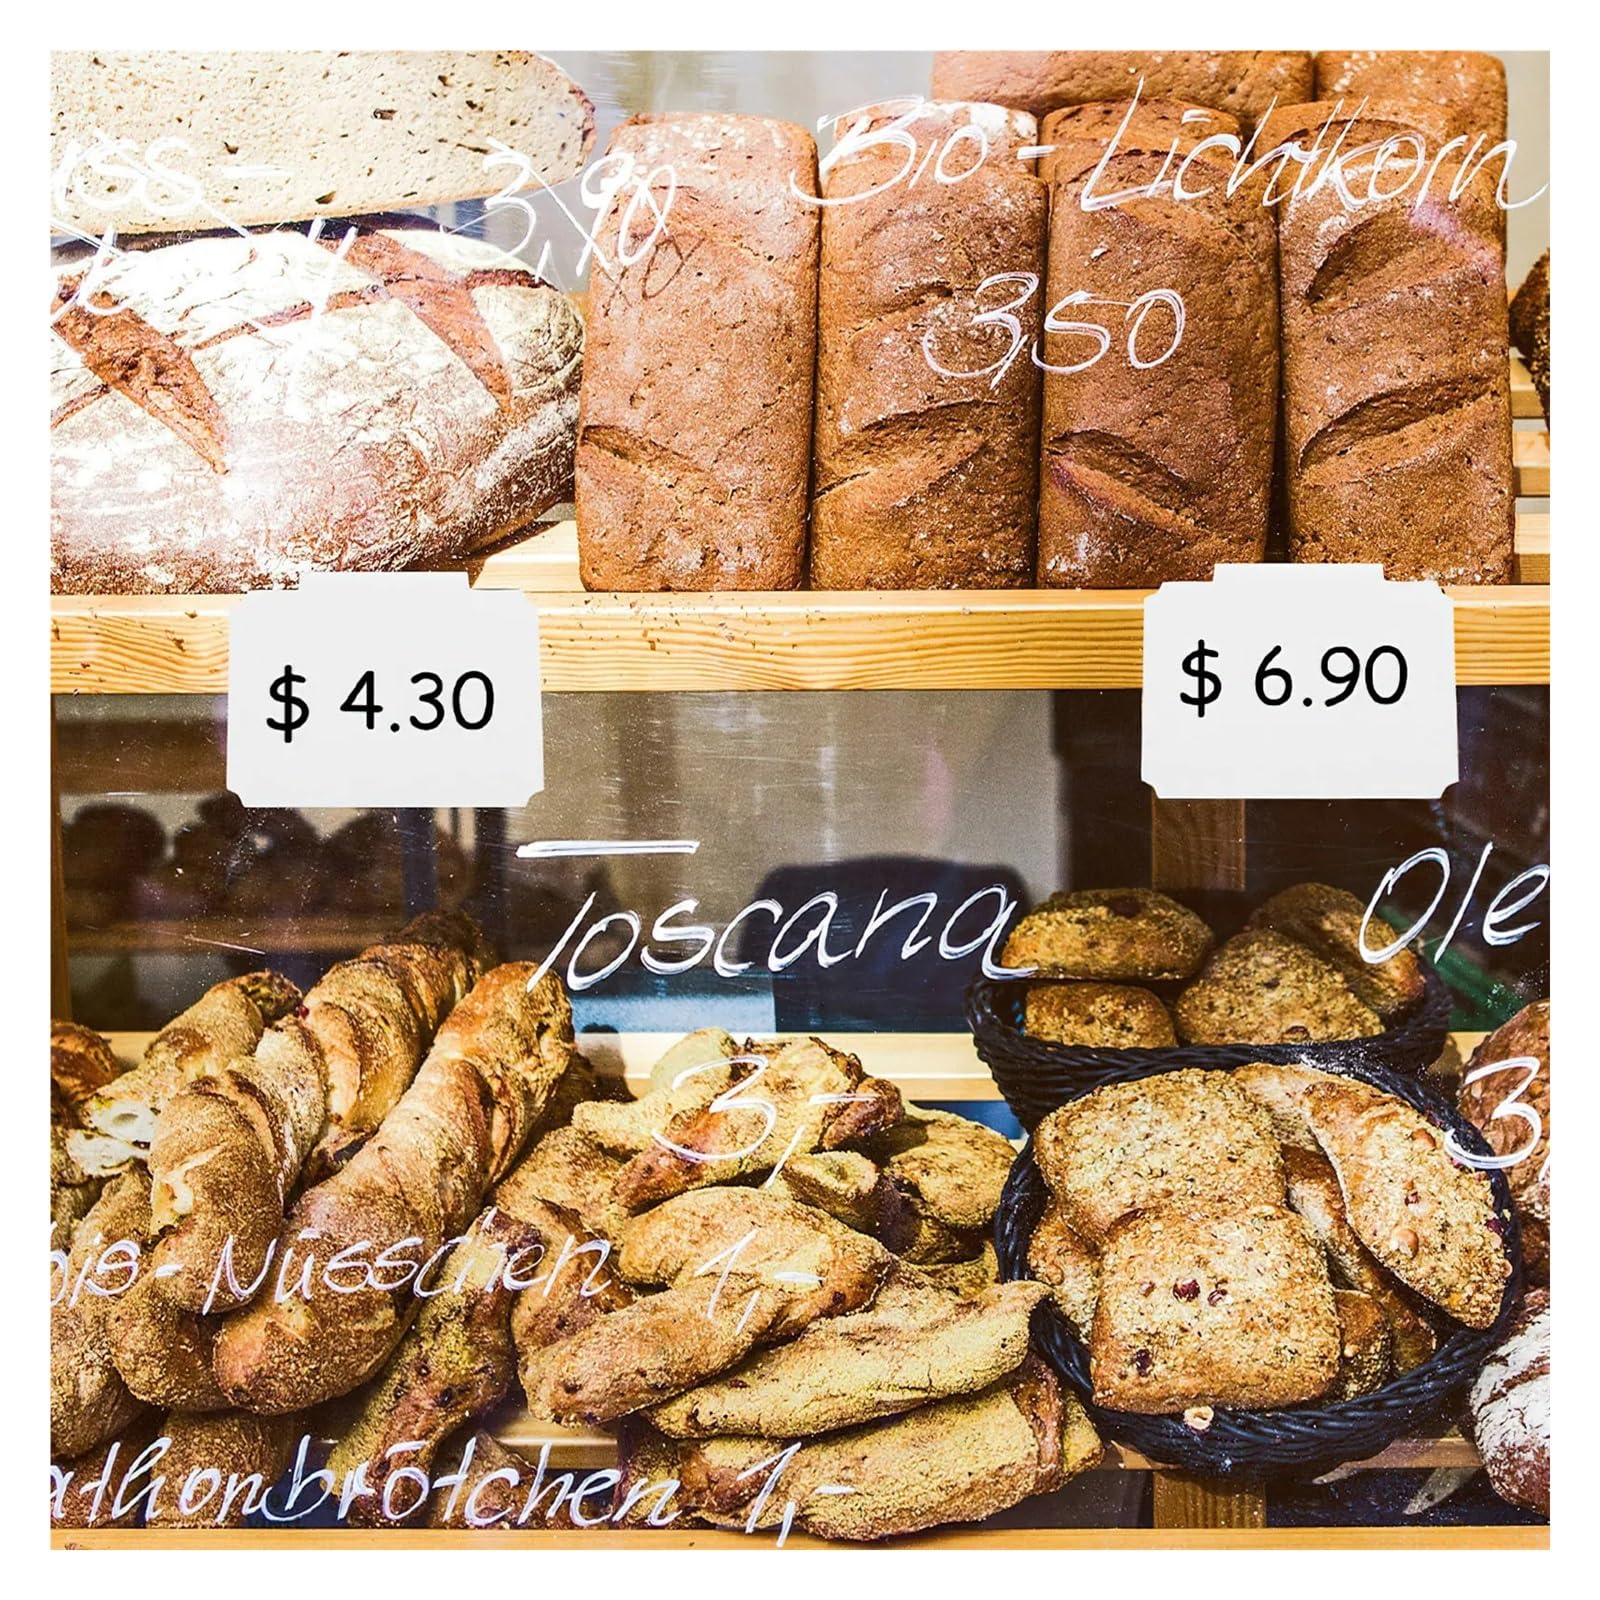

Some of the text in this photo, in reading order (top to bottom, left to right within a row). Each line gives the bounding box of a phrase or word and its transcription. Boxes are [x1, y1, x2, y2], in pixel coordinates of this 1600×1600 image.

[924, 271, 1186, 390] 3,50
[266, 665, 496, 744] $ 4.30
[1180, 639, 1409, 718] $ 6.90
[517, 838, 1039, 994] Toscana
